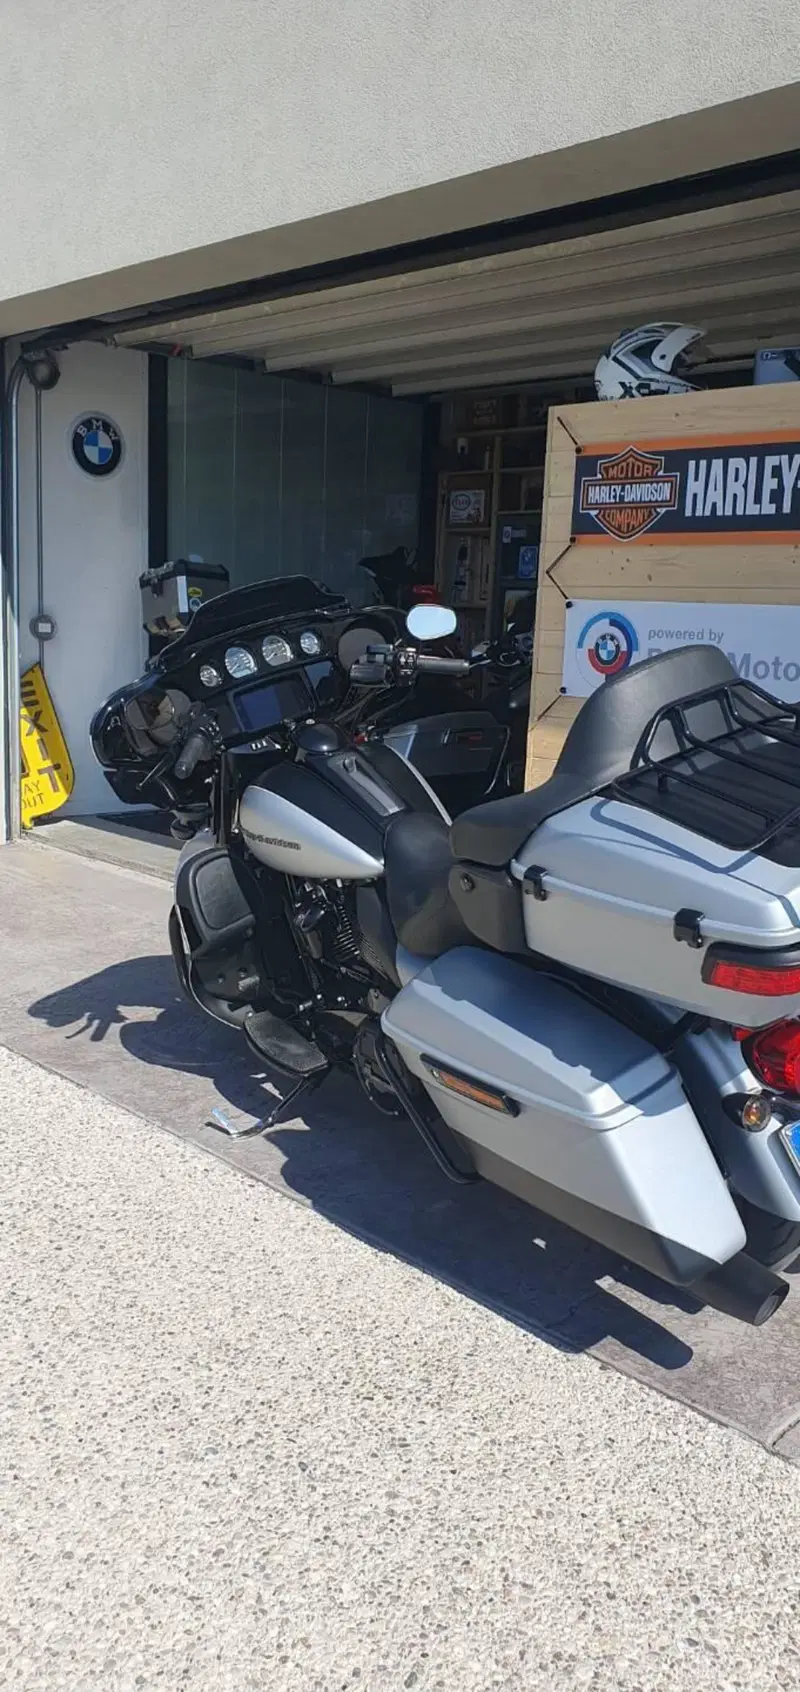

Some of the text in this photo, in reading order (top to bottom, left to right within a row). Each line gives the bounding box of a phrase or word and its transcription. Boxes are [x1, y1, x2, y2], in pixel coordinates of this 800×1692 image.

[76, 418, 120, 440] BMW
[608, 462, 653, 479] MOTOR
[587, 482, 671, 504] HARLEY-DAVIDSON
[685, 454, 800, 517] HARLEY
[605, 508, 650, 533] COMPANY
[648, 628, 724, 644] powered by
[727, 652, 800, 682] Moto
[23, 779, 41, 795] AY
